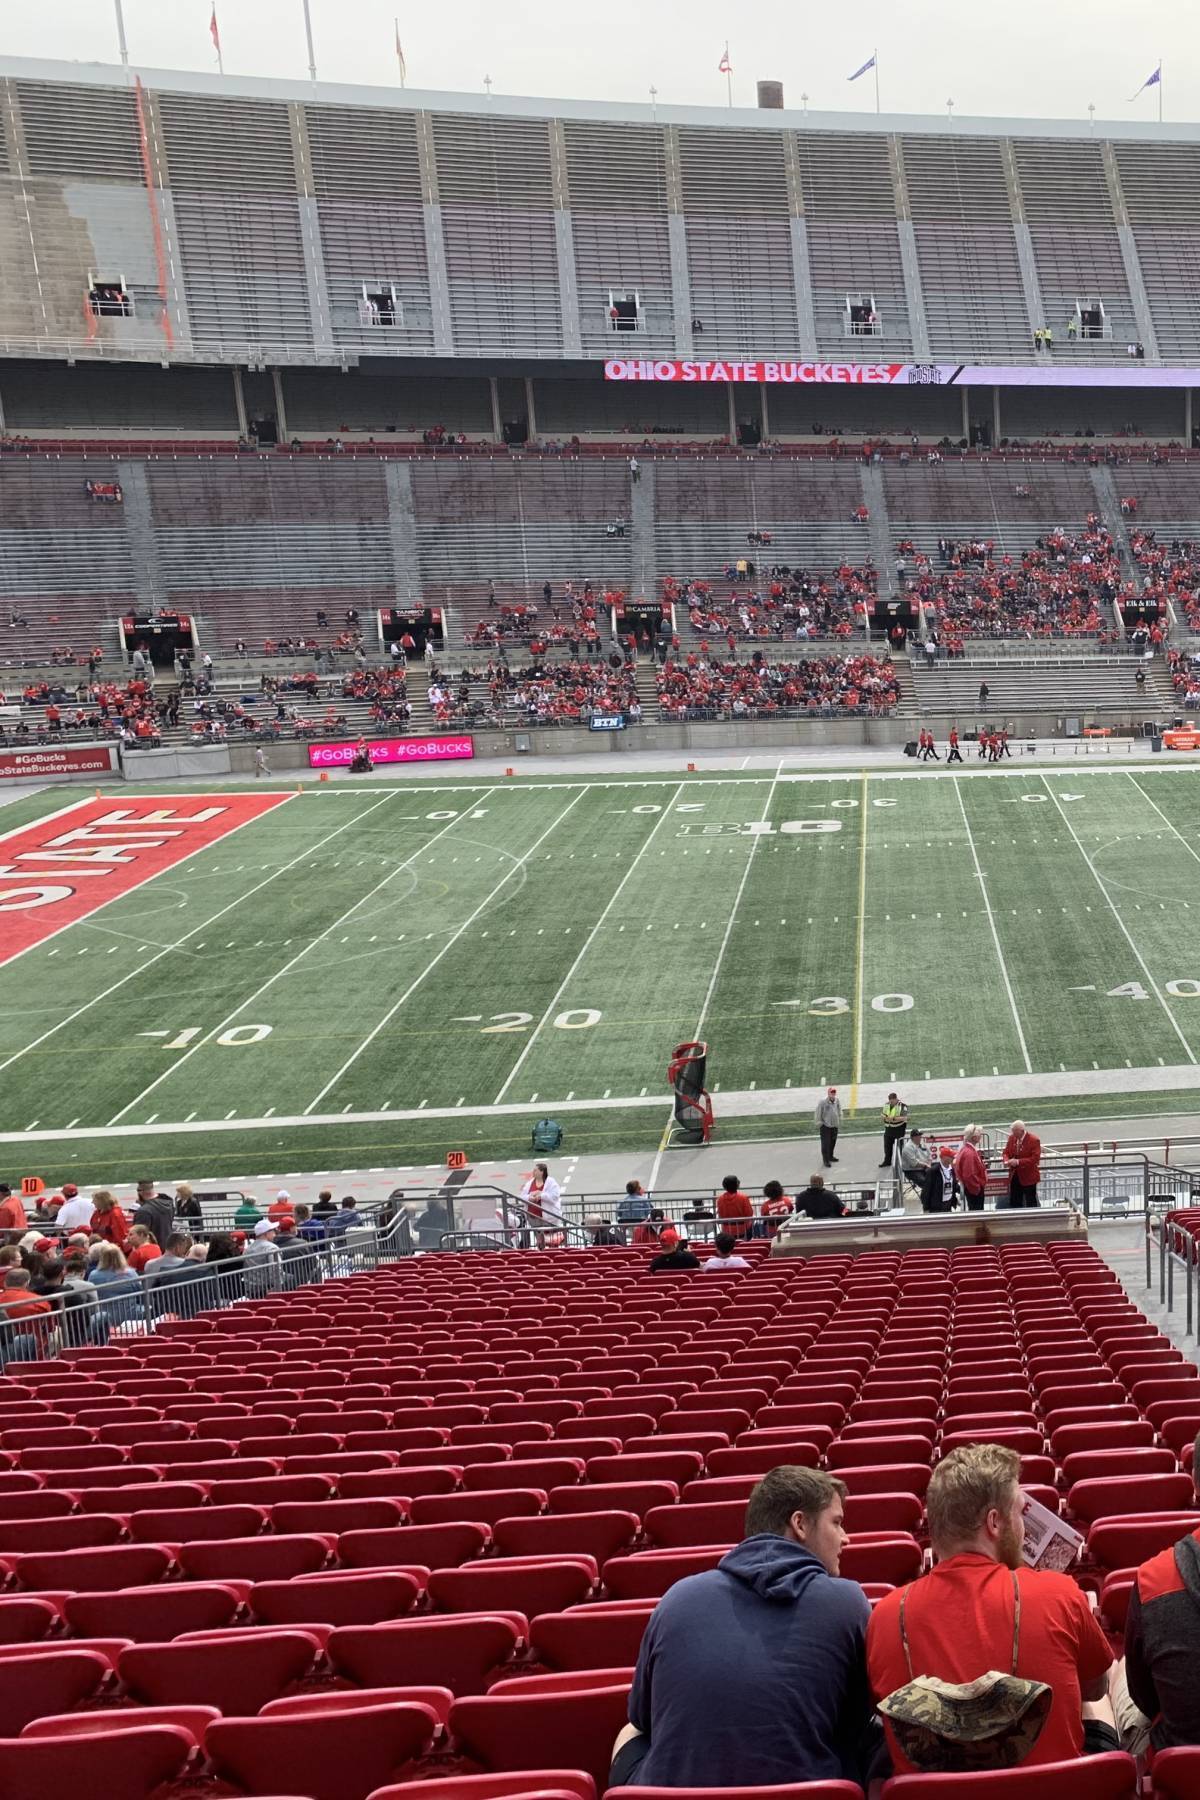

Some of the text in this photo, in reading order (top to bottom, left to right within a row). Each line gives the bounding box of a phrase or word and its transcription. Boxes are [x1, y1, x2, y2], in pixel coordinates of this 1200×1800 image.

[605, 360, 891, 384] OHIO STATE BUCKEYES
[593, 718, 618, 727] BTN
[15, 753, 66, 764] #GoBucks
[448, 1152, 463, 1167] 20
[24, 1178, 37, 1194] 10
